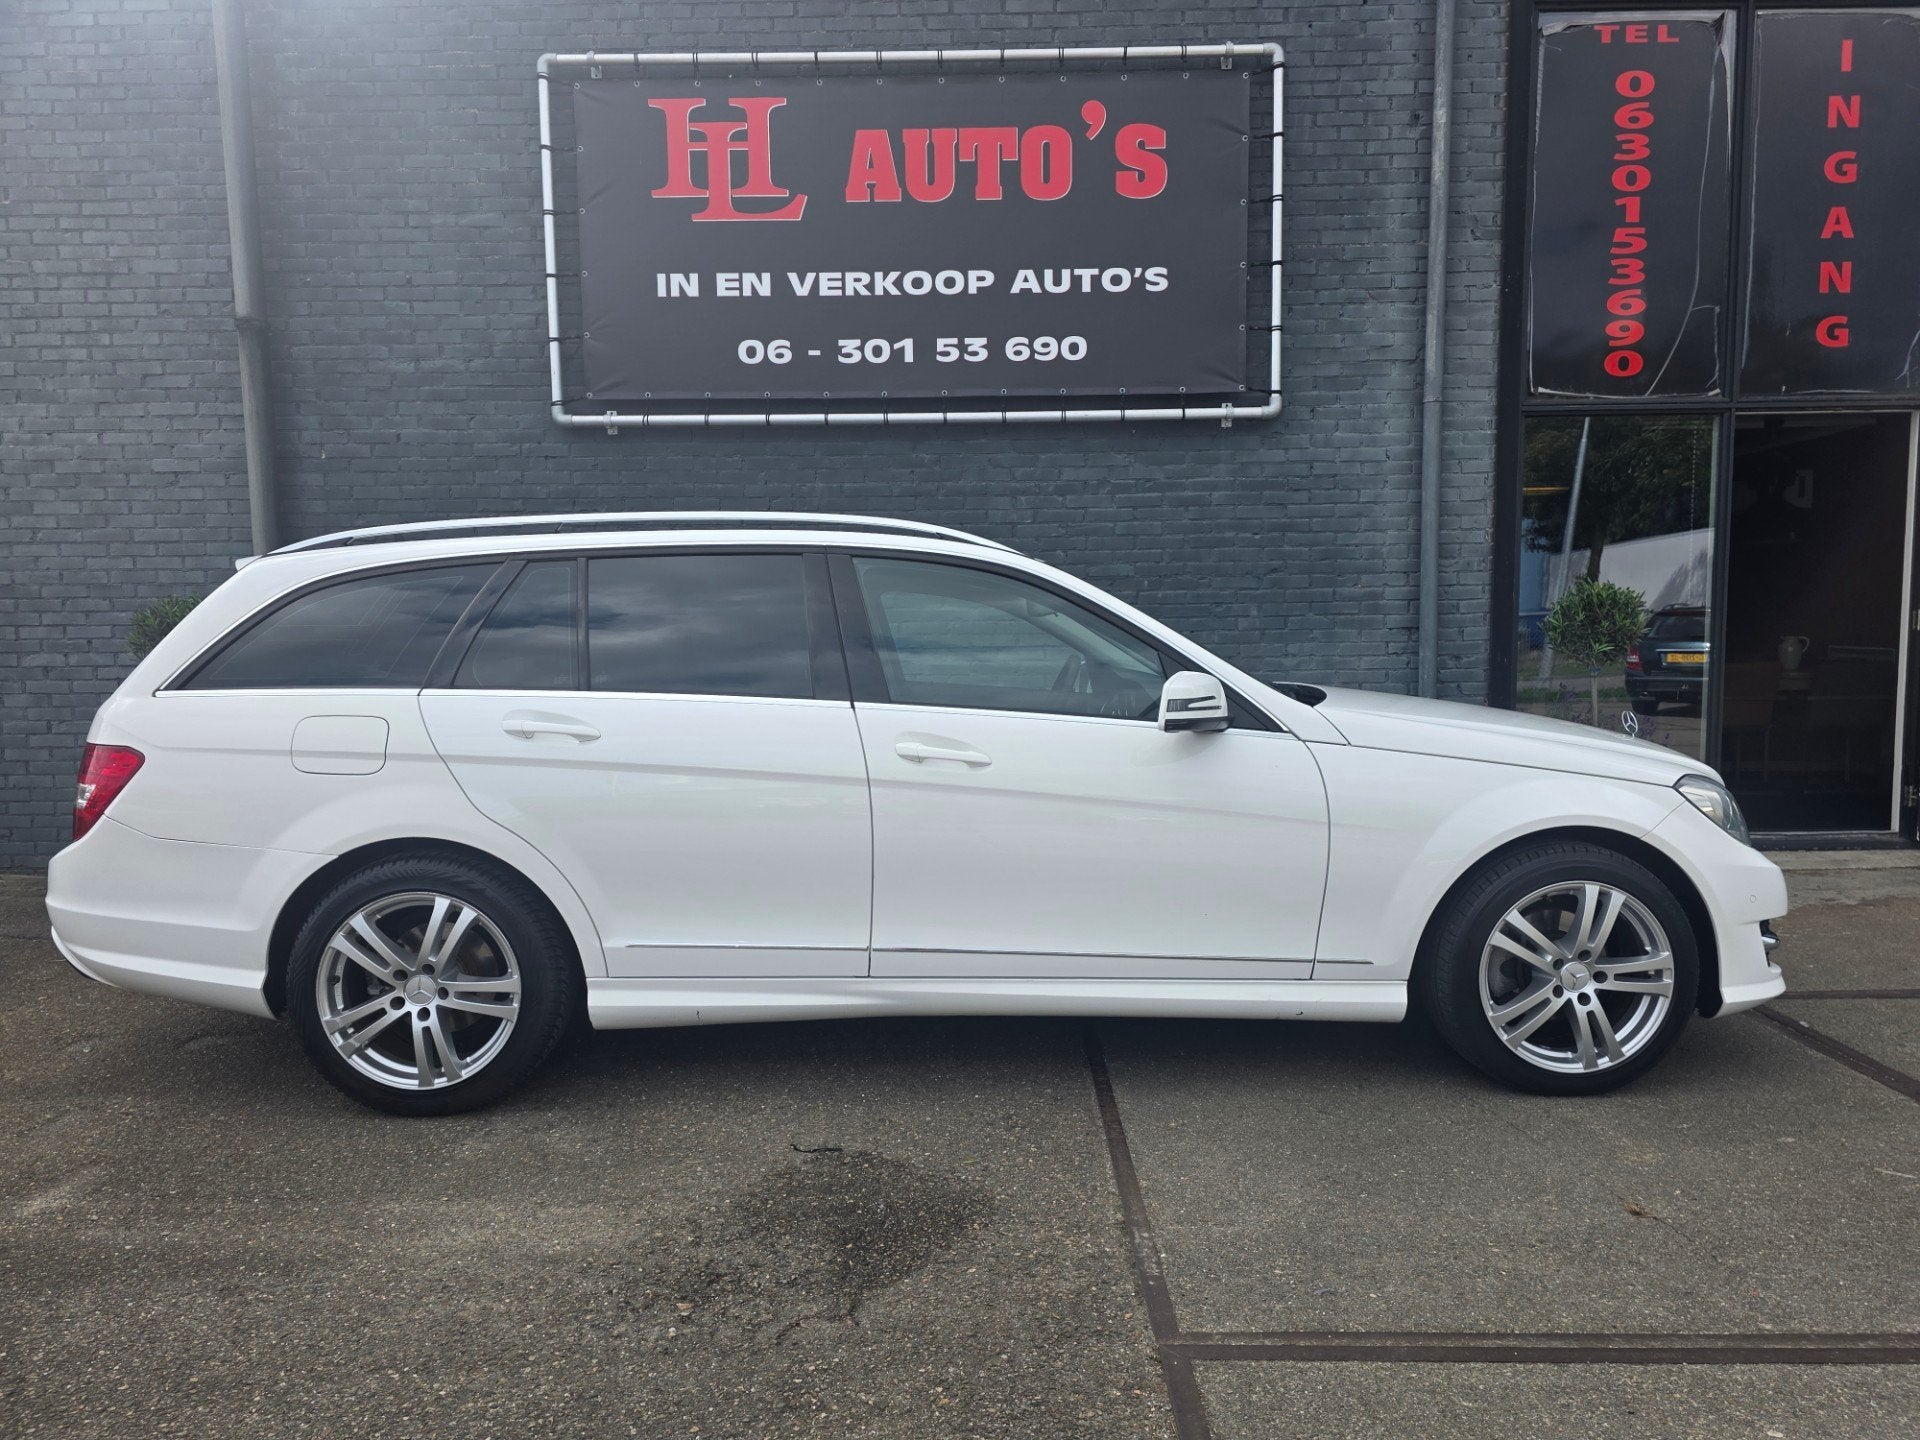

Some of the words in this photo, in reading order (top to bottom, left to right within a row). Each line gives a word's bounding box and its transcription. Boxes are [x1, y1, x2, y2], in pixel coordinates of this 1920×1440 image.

[1594, 25, 1680, 43] TEL
[845, 100, 1167, 203] AUTO'S
[1603, 70, 1656, 378] 0630153690
[1815, 39, 1861, 348] INGANG
[656, 272, 700, 298] IN
[715, 272, 772, 297] EN
[786, 269, 995, 297] VERKOOP
[1009, 266, 1169, 294] AUTO'S
[737, 339, 793, 365] 06
[837, 337, 914, 364] 301
[935, 337, 989, 363] 53
[1005, 335, 1088, 362] 690
